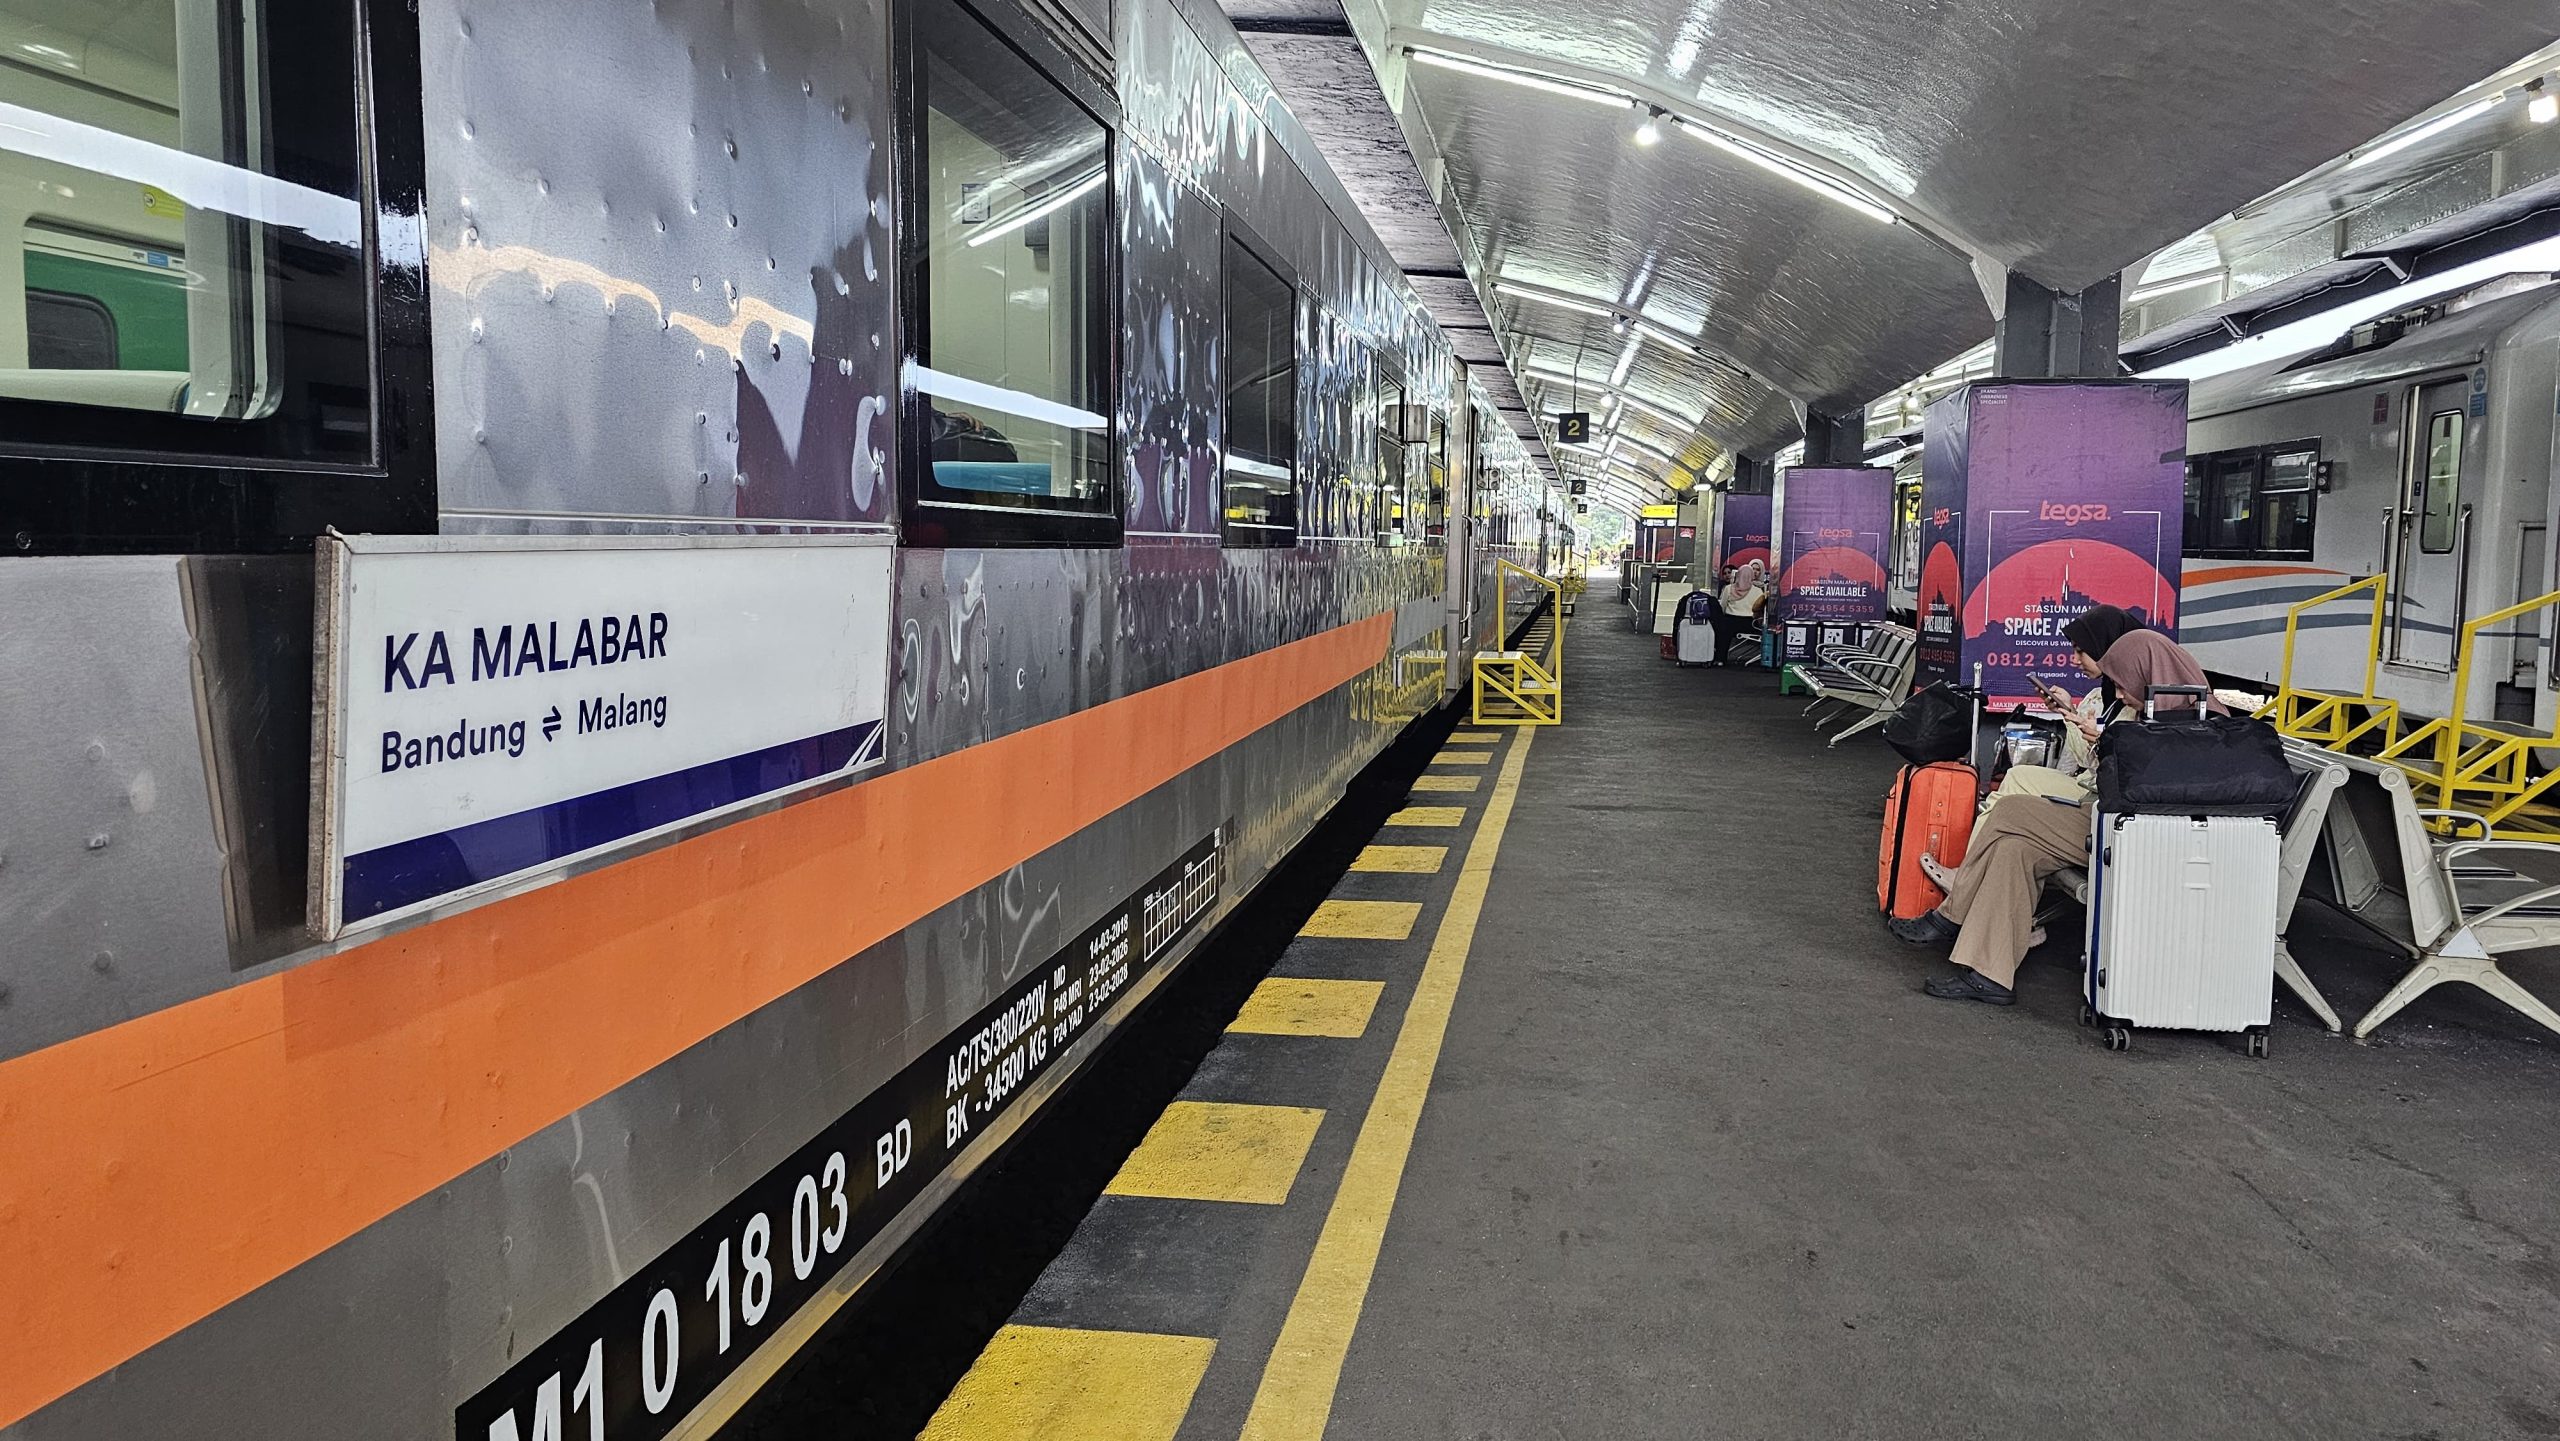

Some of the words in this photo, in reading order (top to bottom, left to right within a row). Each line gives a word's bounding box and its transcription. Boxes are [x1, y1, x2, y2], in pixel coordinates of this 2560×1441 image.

[1568, 419, 1580, 436] 2
[1575, 482, 1582, 492] 2
[1800, 586, 1824, 596] SPACE
[1825, 586, 1867, 597] AVAILABLE
[2004, 618, 2051, 636] SPACE
[2024, 605, 2069, 613] STASIUN
[384, 631, 455, 693] KA
[472, 612, 669, 681] MALABAR
[1987, 652, 2035, 666] 0812
[2042, 653, 2080, 667] 495
[381, 718, 526, 773] Bandung
[578, 693, 667, 734] Malang
[1054, 965, 1066, 990] MD
[1089, 913, 1129, 959] 14-03-2018
[1054, 991, 1067, 1019] P48
[1068, 978, 1082, 1006] MRI
[1089, 938, 1128, 988] 23-02-2026
[946, 979, 1047, 1099] AC/TS/380/220V
[1054, 1018, 1067, 1047] P24
[1068, 1005, 1083, 1032] YAD
[1088, 962, 1128, 1013] 23-02-2028
[946, 1093, 968, 1149] BK
[984, 1045, 1025, 1112] 34500
[1029, 1024, 1047, 1071] KG
[642, 1288, 679, 1414] 0
[706, 1212, 772, 1354] 18
[792, 1151, 848, 1280] 03
[877, 1118, 912, 1189] BD
